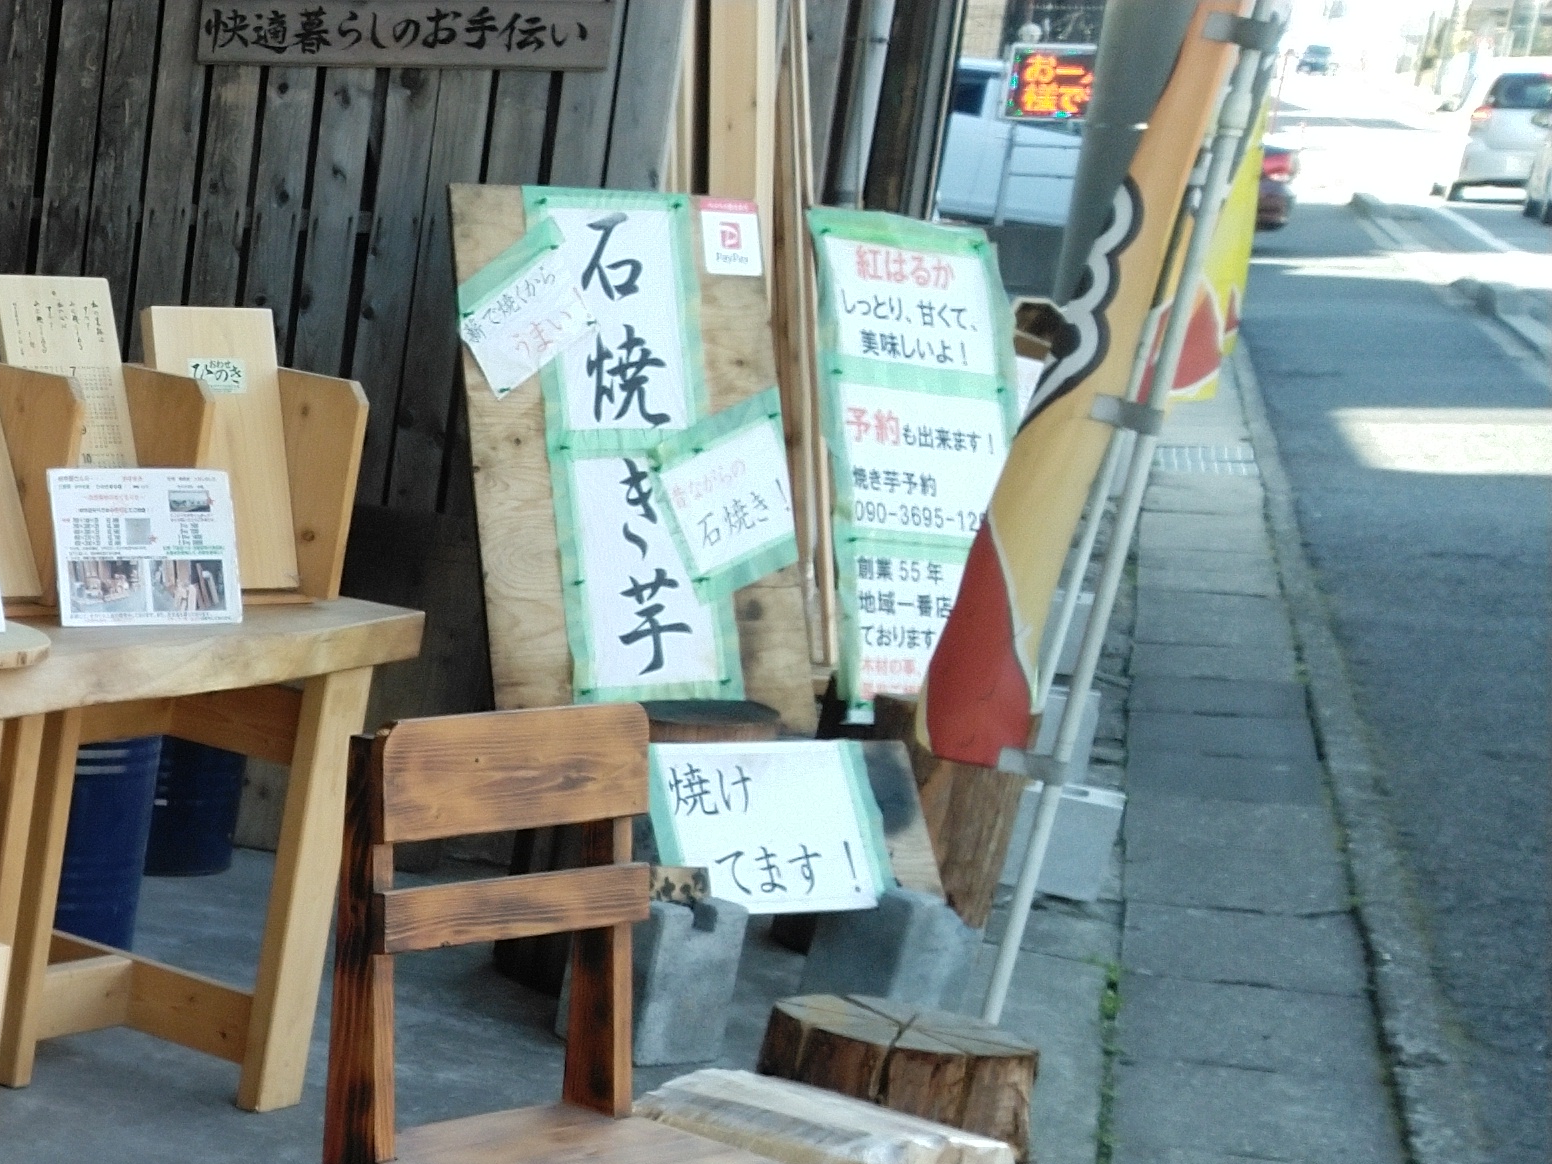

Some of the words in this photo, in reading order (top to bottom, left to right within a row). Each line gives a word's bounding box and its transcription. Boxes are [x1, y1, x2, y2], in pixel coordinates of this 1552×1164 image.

[205, 6, 588, 55] 快適暮らしのお手伝い
[855, 245, 954, 290] 紅はるか
[841, 288, 978, 332] しっとり、甘くて、
[859, 328, 969, 367] 美味しいよ！
[581, 212, 693, 675] 石焼き芋
[846, 406, 994, 455] 予約も出来ます！
[852, 464, 938, 497] 焼き芋予約
[860, 625, 936, 649] ております
[668, 762, 752, 816] 焼け
